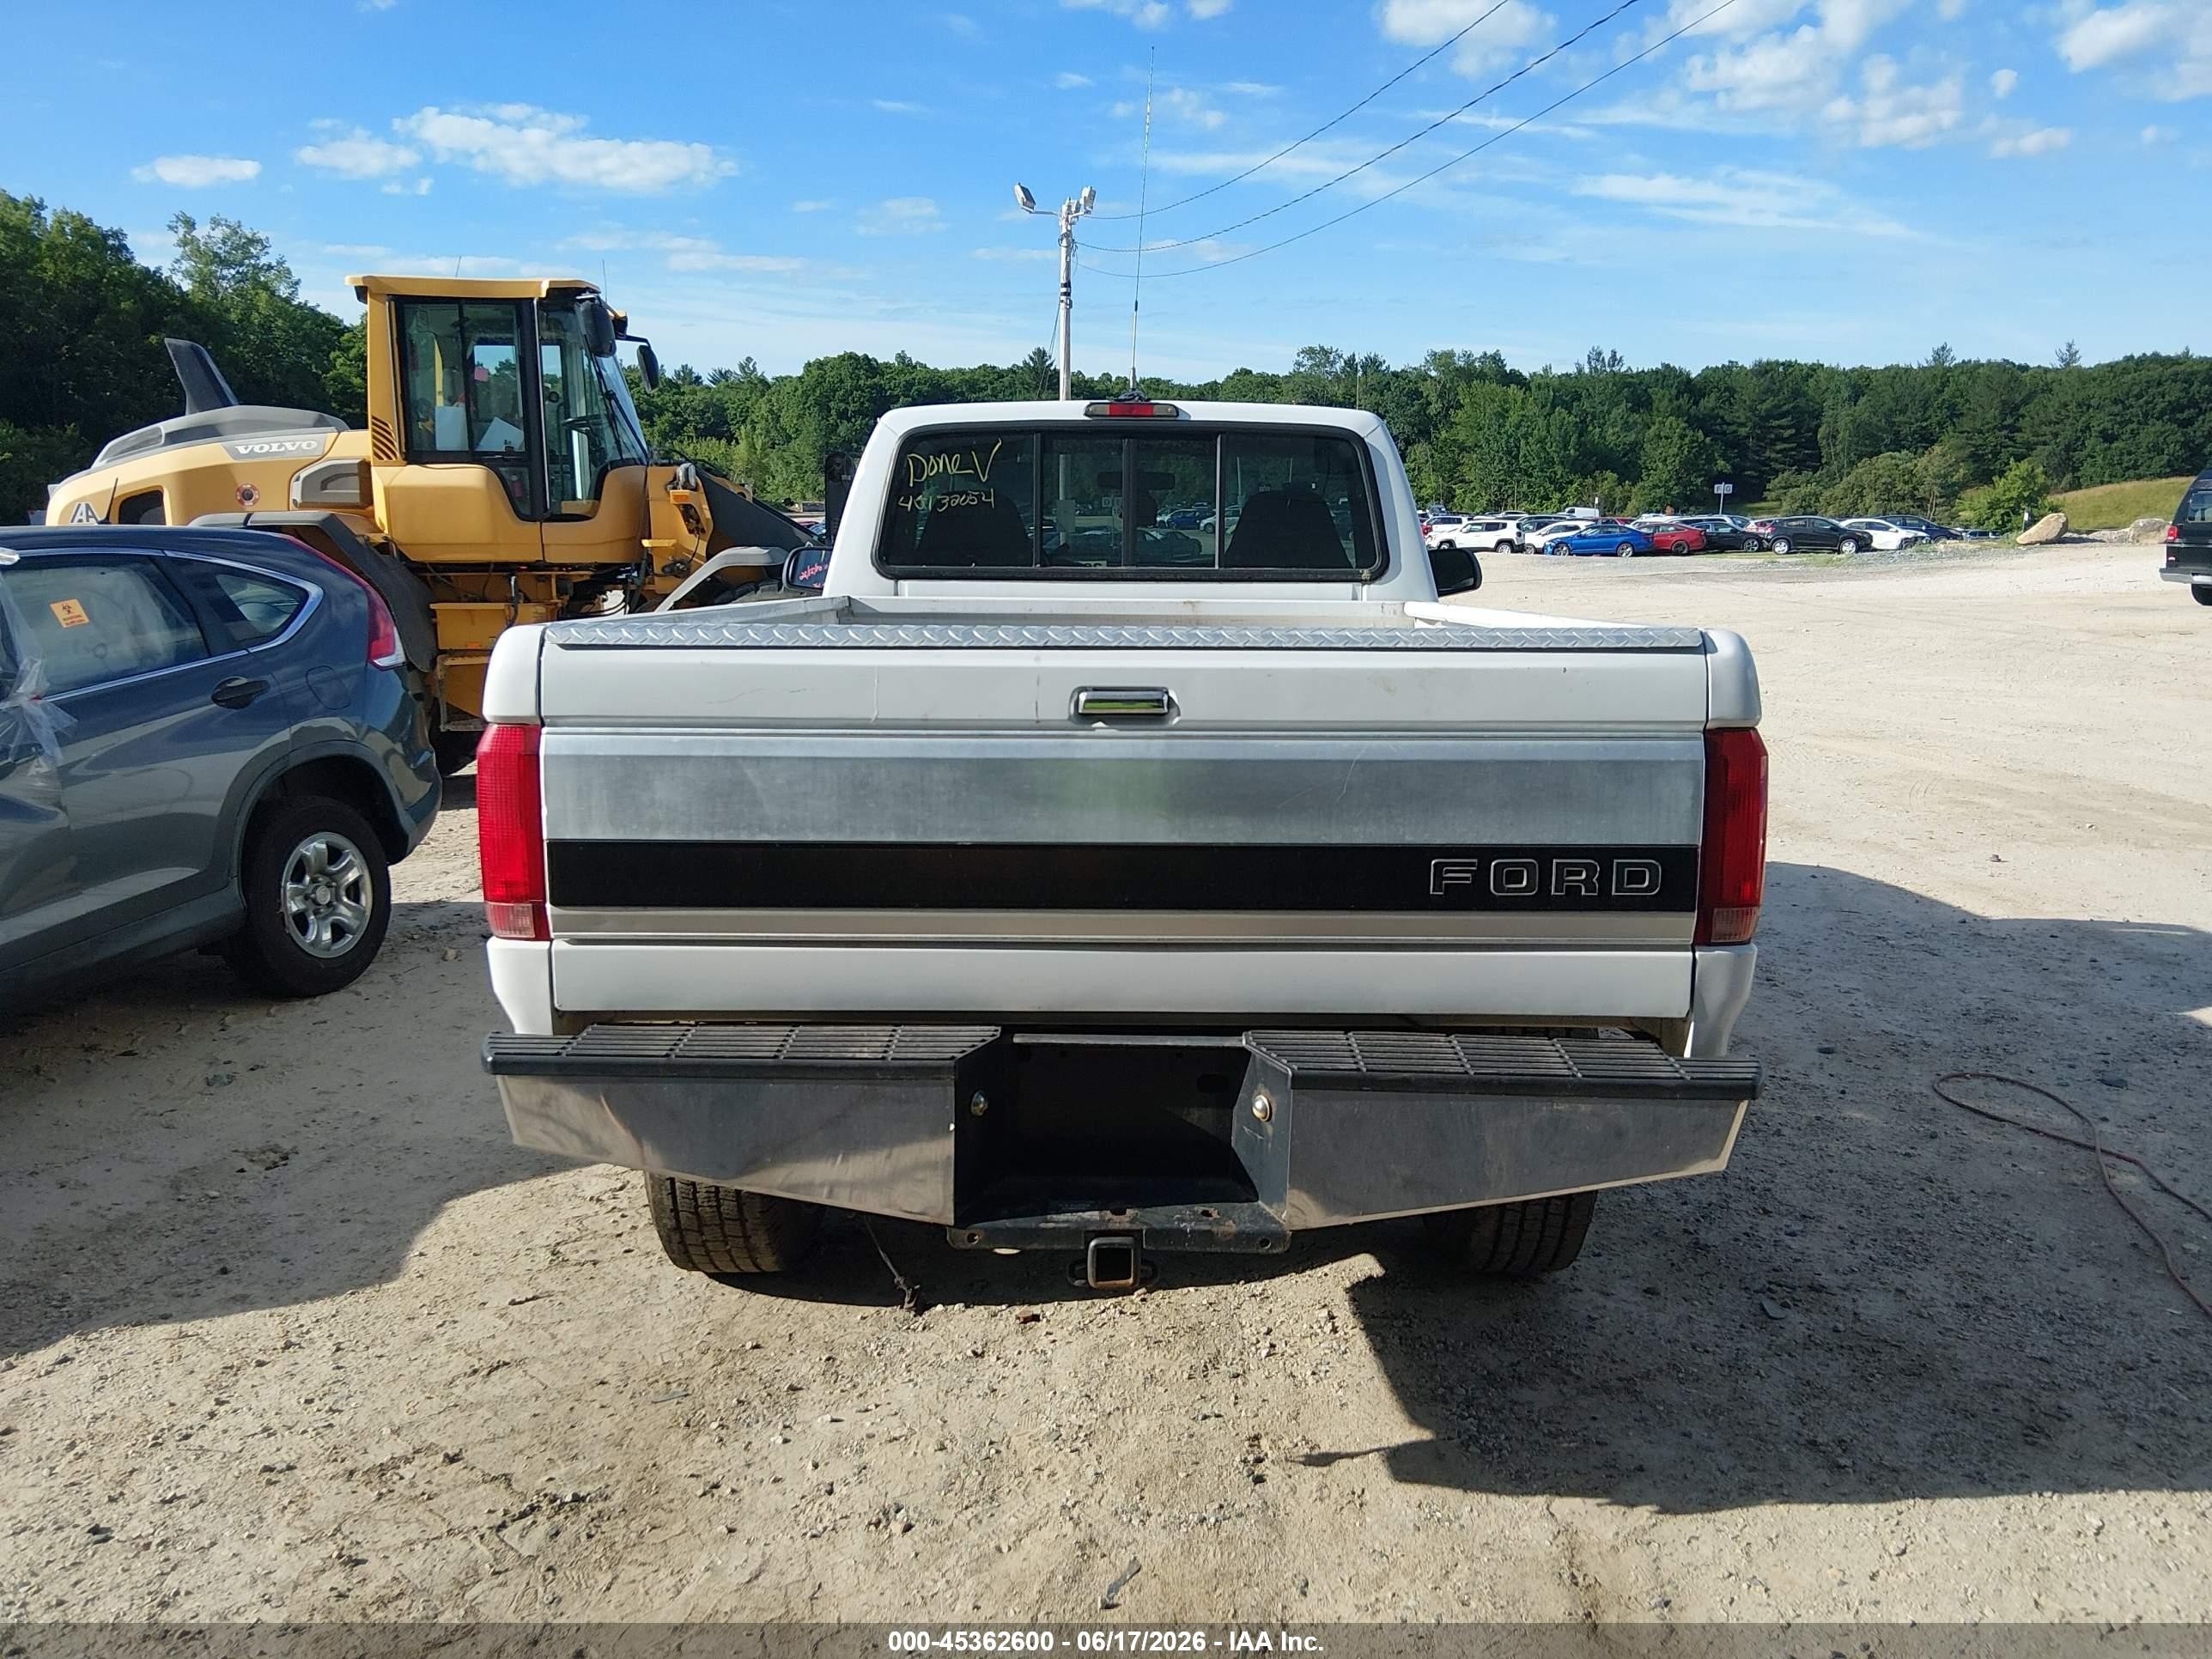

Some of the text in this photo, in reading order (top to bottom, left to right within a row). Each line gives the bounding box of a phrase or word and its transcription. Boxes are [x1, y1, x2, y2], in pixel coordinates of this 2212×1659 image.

[234, 440, 318, 454] VOLVO
[907, 453, 975, 487] Done
[1430, 859, 1662, 896] FORD
